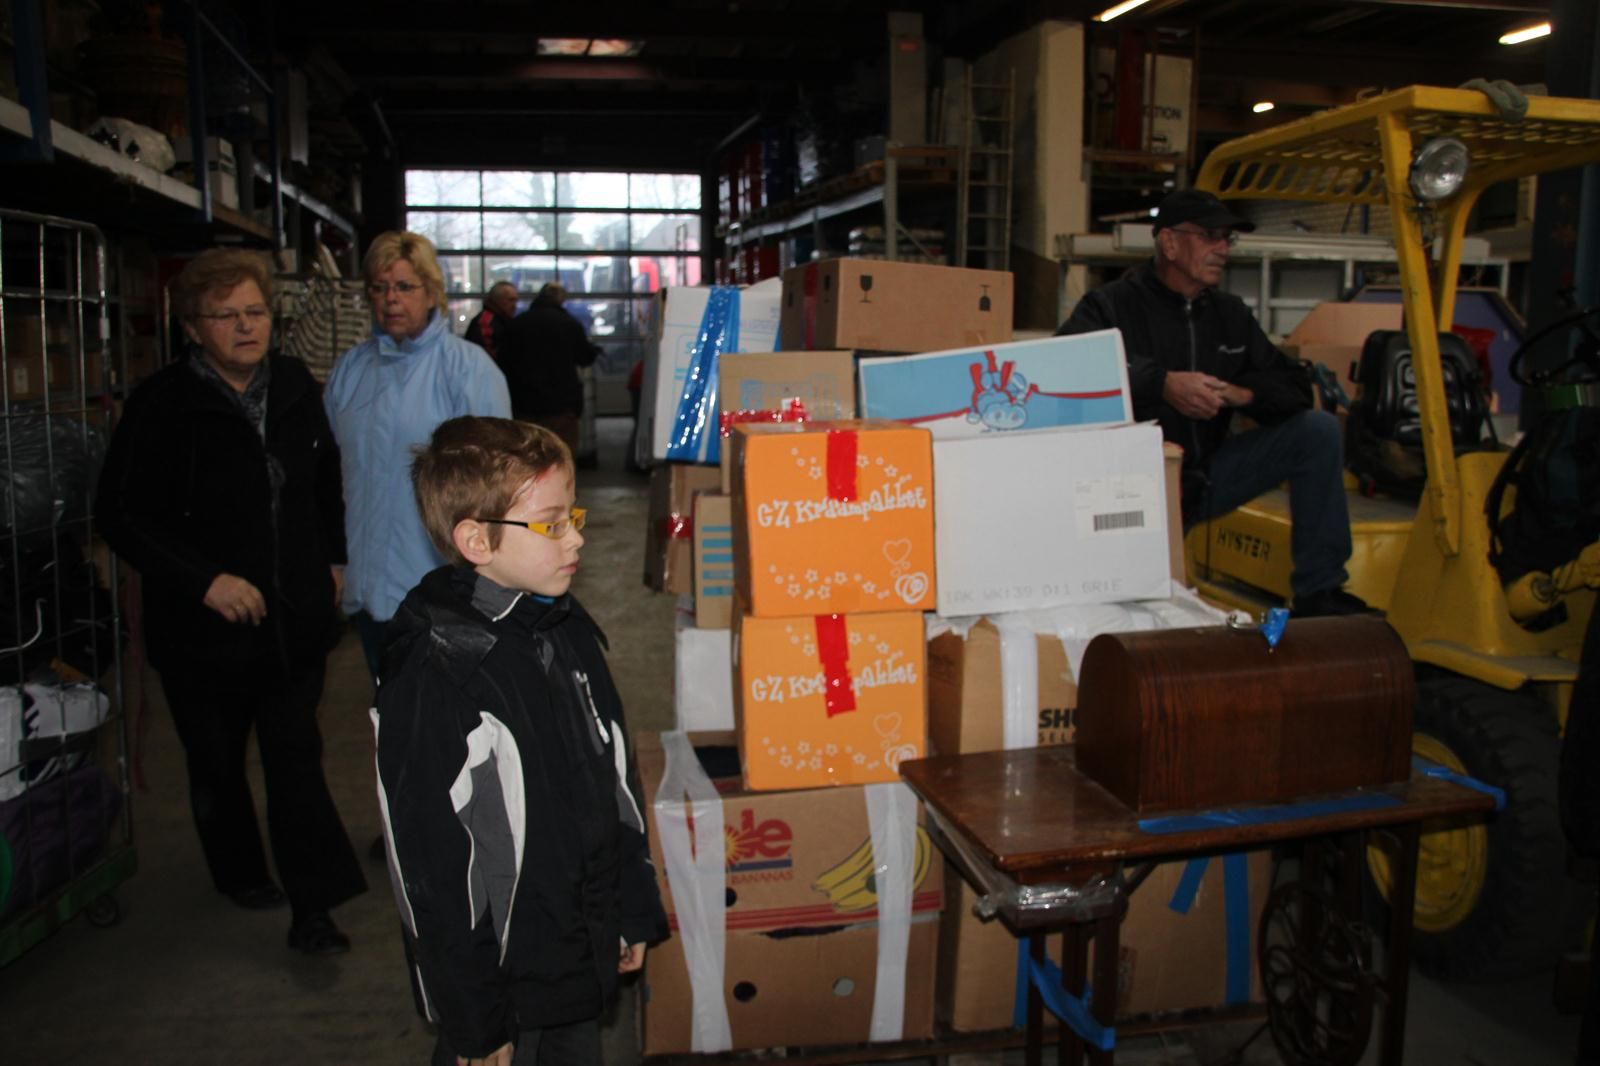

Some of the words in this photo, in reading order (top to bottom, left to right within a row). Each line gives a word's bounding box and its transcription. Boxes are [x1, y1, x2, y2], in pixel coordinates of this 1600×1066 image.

[758, 496, 791, 529] GZ
[1216, 527, 1272, 562] HYSTER
[751, 674, 785, 704] GZ
